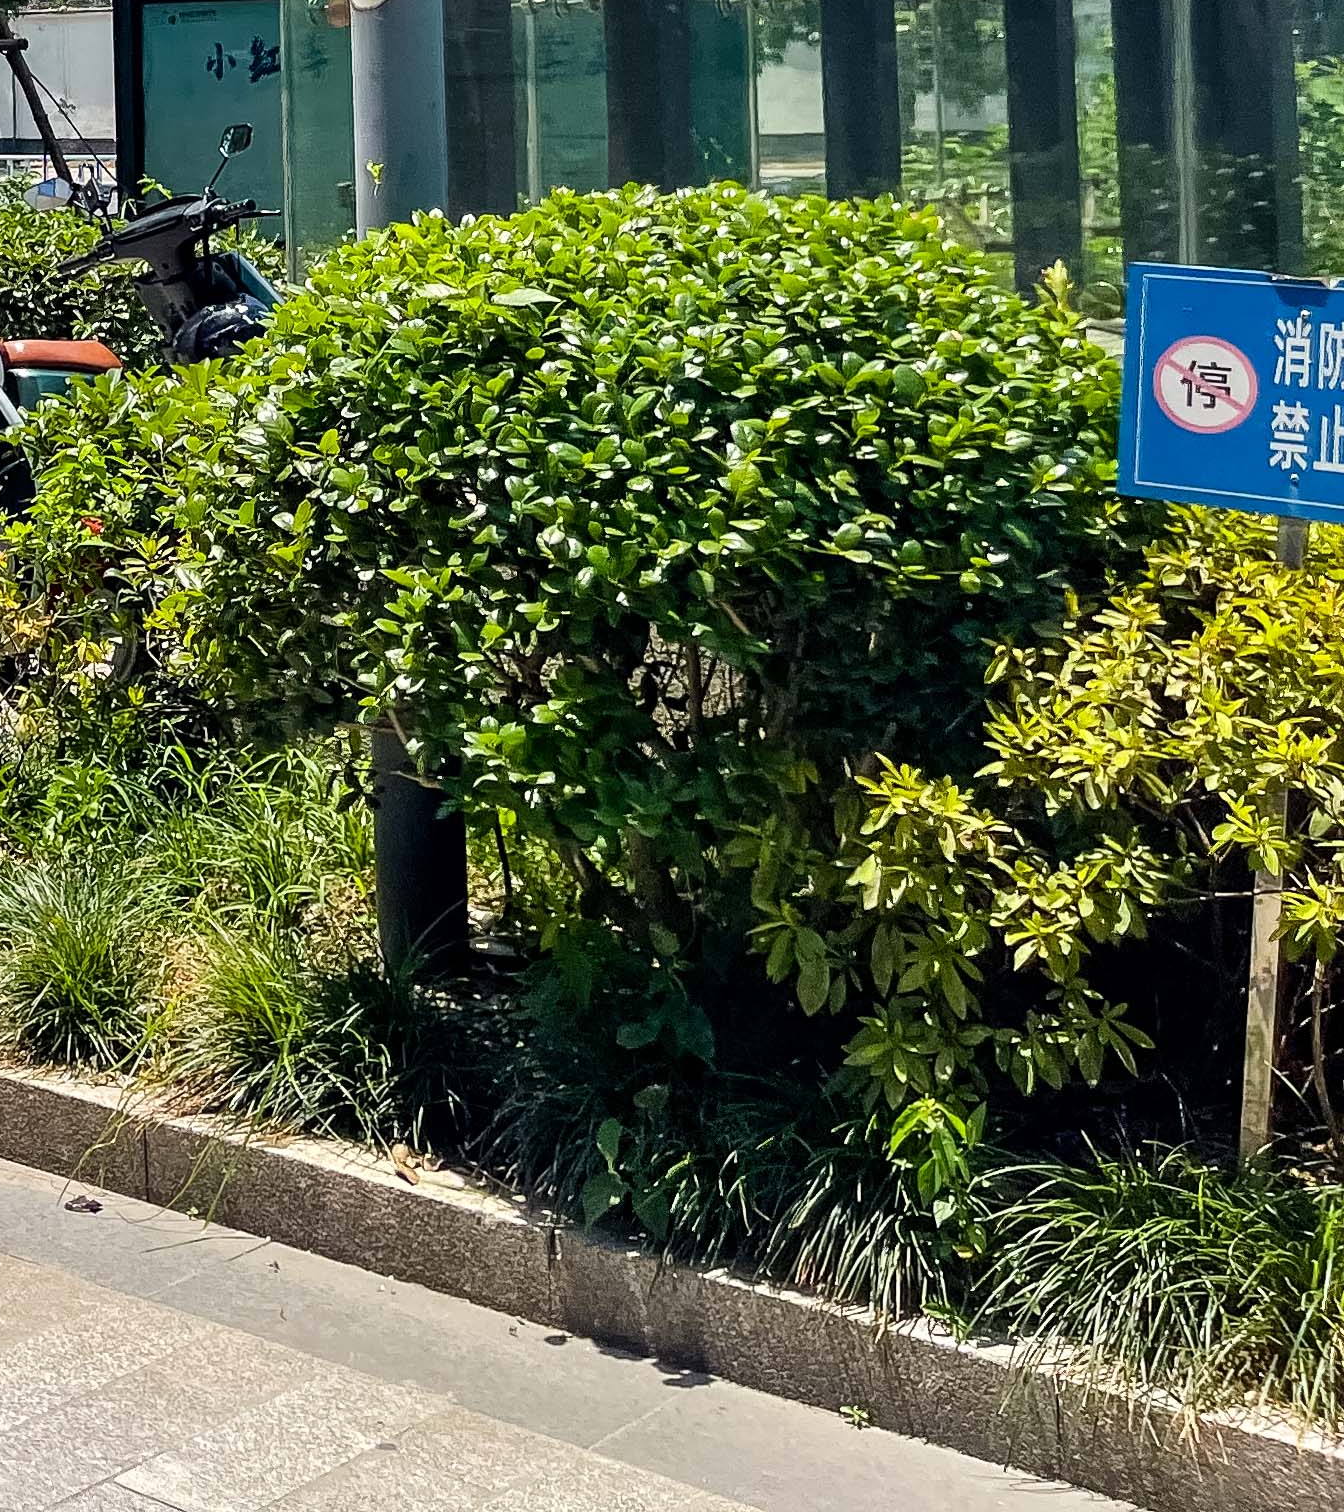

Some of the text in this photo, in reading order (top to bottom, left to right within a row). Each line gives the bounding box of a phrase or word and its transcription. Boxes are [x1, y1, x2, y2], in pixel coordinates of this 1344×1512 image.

[1180, 359, 1232, 410] 停
[1273, 317, 1344, 390] 消防
[1269, 399, 1344, 473] 禁止
